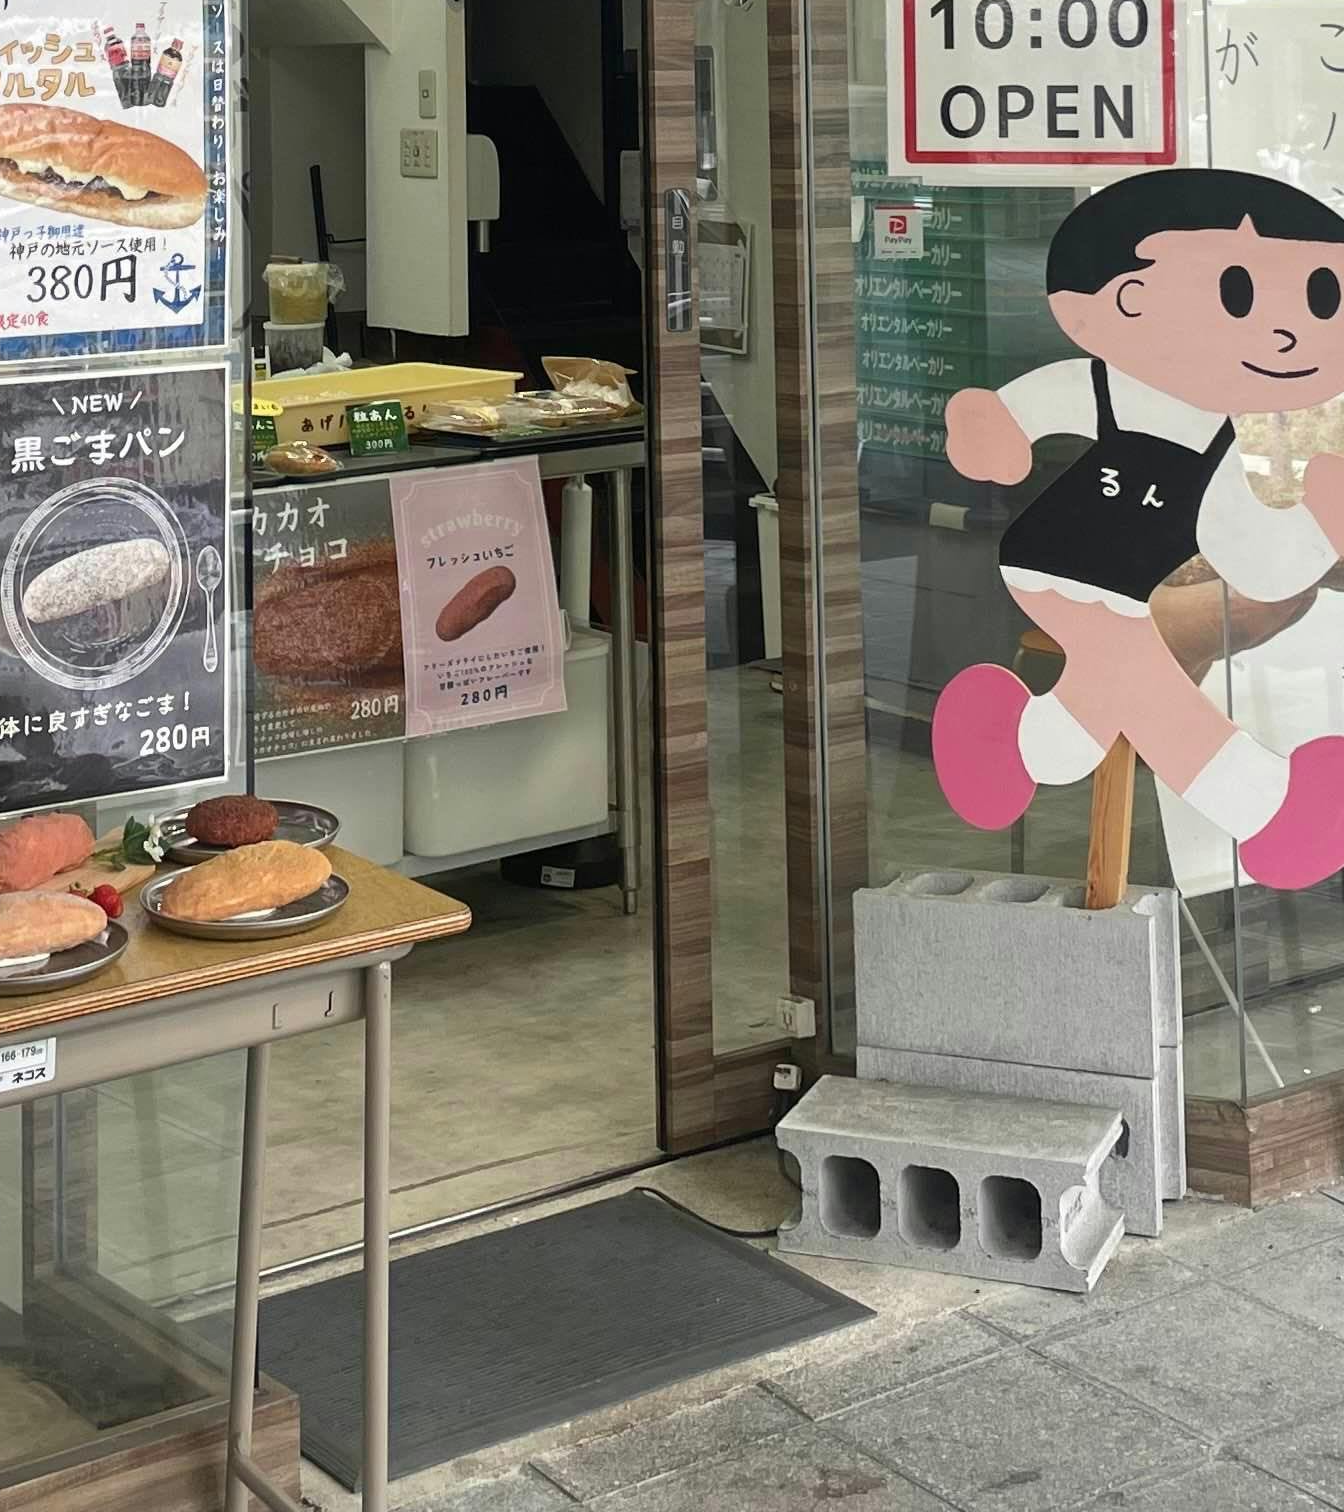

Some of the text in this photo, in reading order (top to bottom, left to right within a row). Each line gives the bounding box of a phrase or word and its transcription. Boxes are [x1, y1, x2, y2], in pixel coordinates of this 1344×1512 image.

[938, 83, 1136, 140] OPEN
[884, 236, 912, 245] PayPay
[26, 253, 138, 304] 380円
[854, 274, 963, 305] オリエンタルベーカリー
[859, 312, 953, 340] オリエンタルベーカリー
[861, 349, 954, 377] オリエンタルベーカリー
[70, 392, 124, 415] NEW
[856, 386, 948, 415] オリエンタルベーカ
[10, 426, 186, 474] 黒ごまパン
[1100, 467, 1164, 508] るん
[252, 496, 331, 536] カカオ
[421, 508, 525, 549] strawberry
[426, 543, 514, 569] フレッシュいちご
[350, 694, 399, 720] 280円
[460, 684, 508, 706] 280円
[139, 725, 211, 757] 280円
[12, 1067, 46, 1084] ネコス
